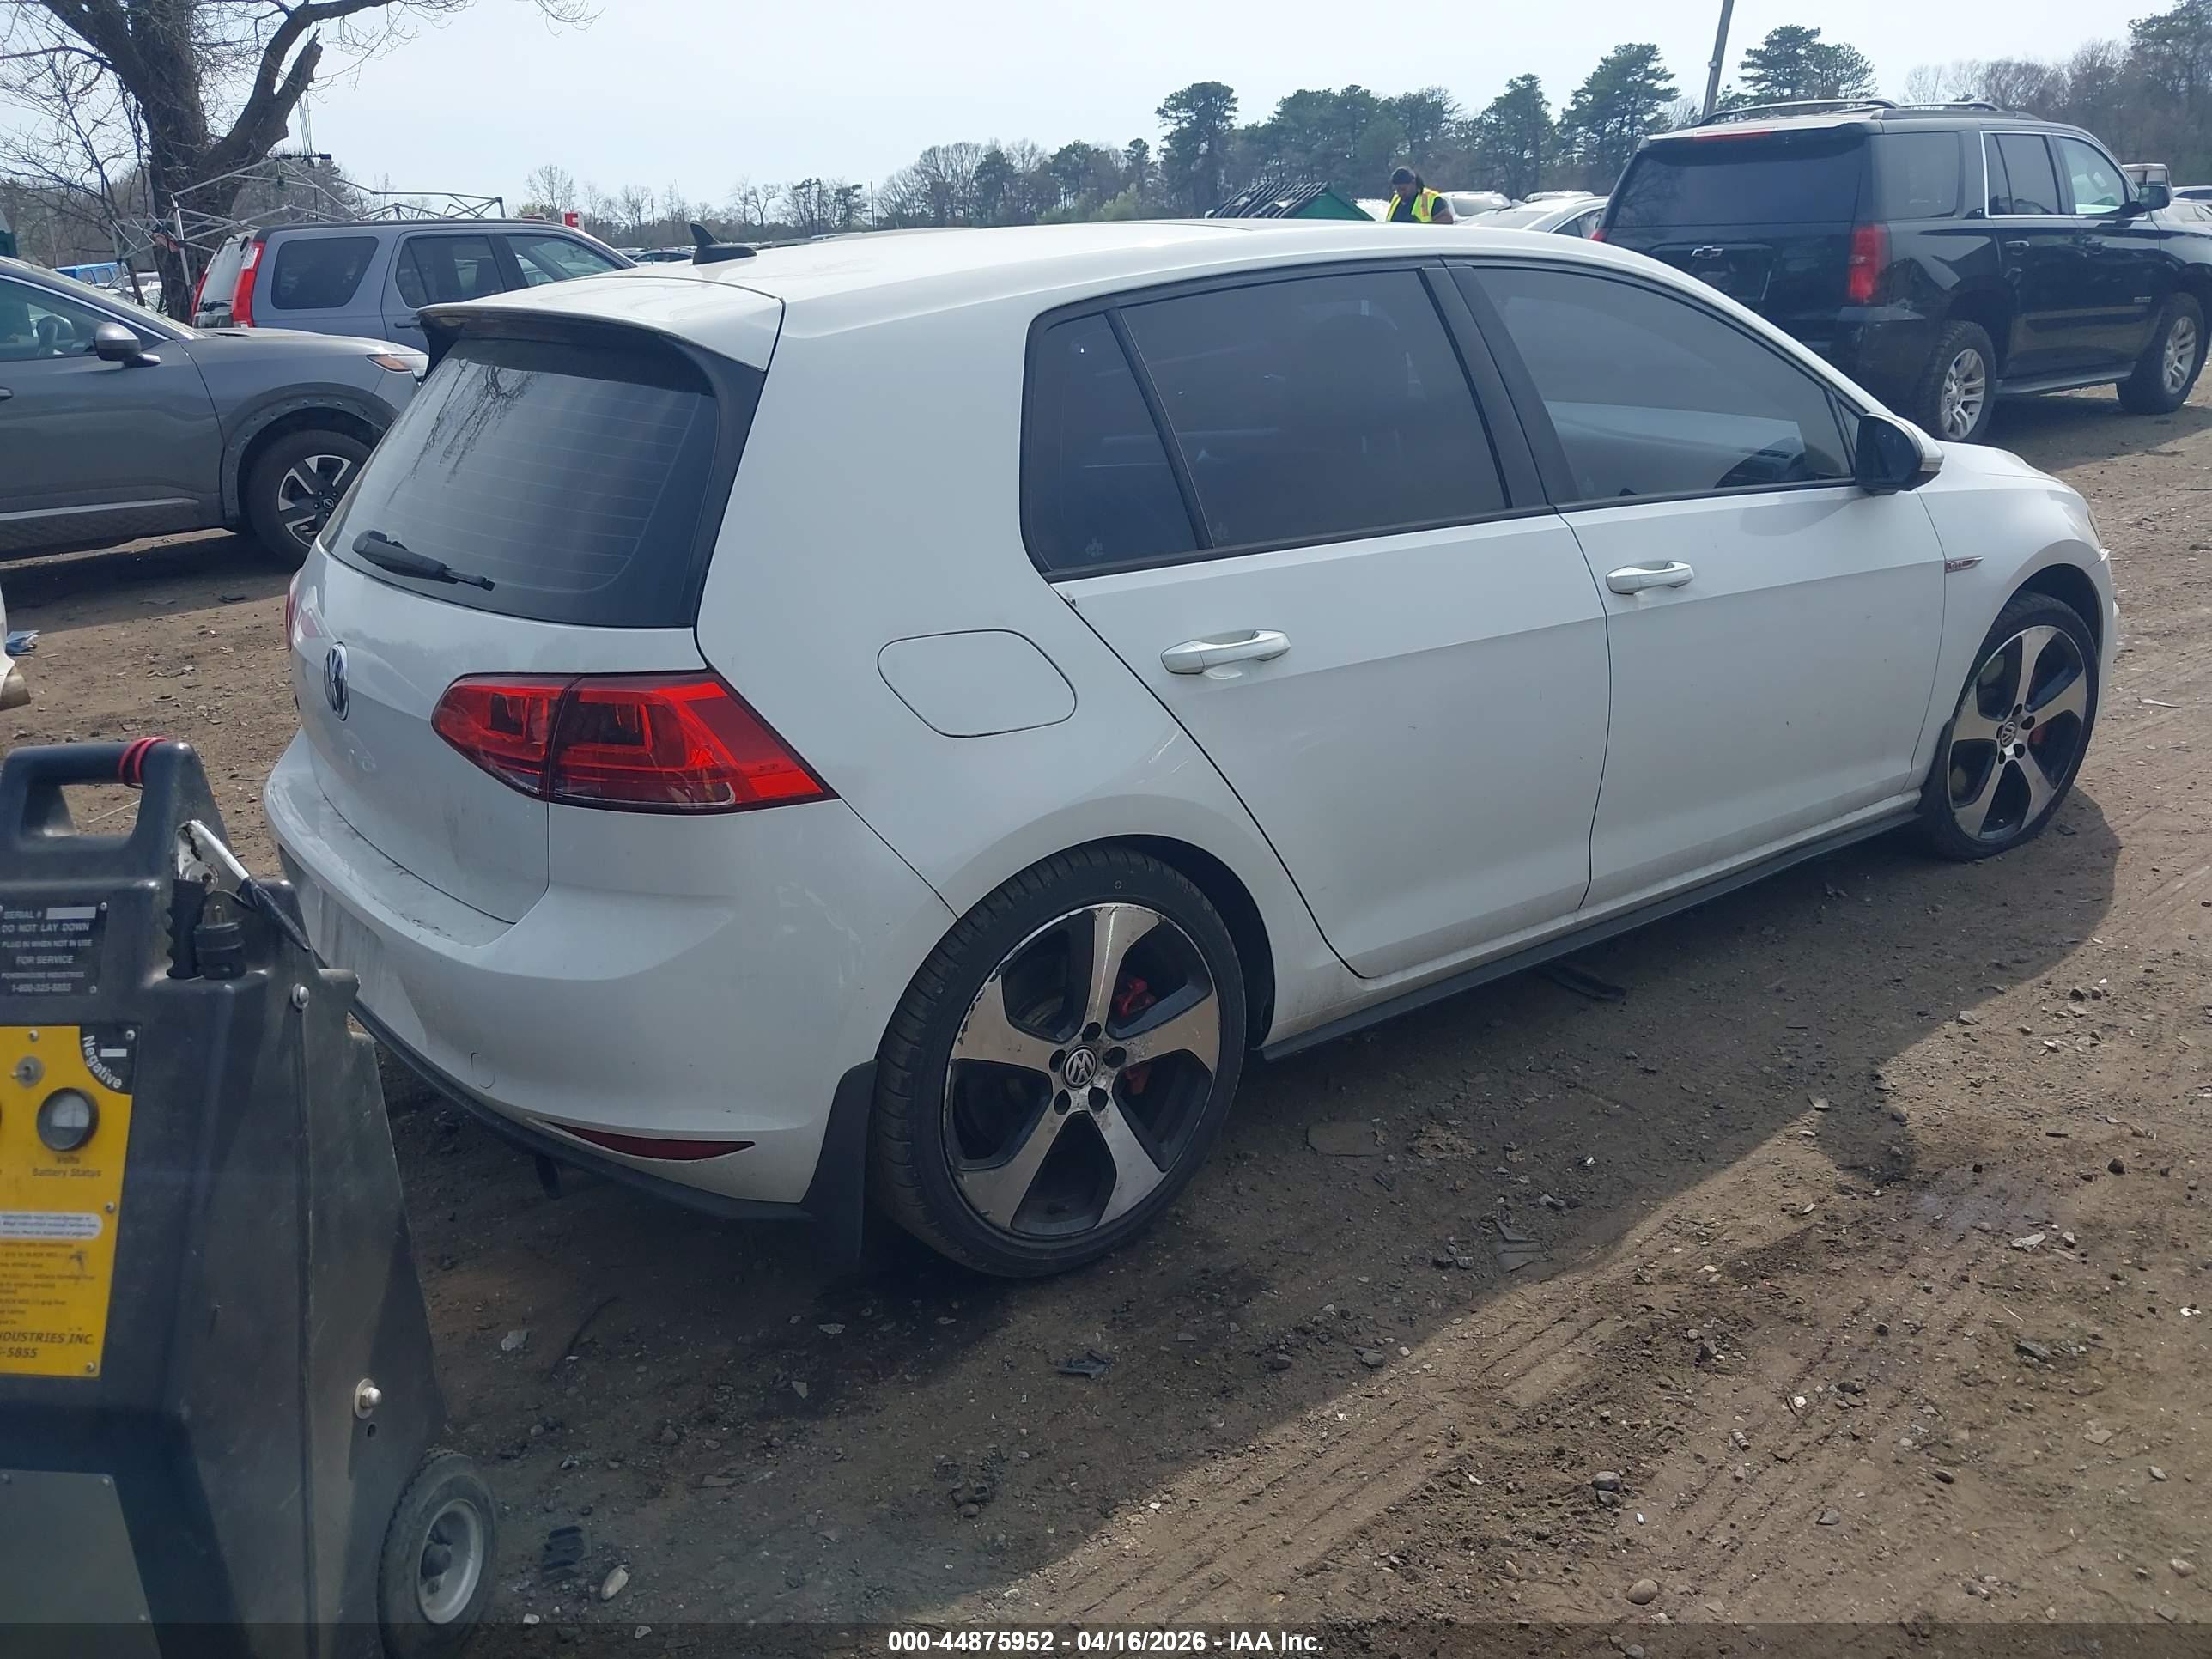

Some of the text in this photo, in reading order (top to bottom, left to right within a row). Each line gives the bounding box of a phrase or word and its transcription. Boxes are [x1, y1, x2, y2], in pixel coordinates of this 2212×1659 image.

[3, 910, 34, 920] SERIAL
[2, 924, 15, 933] DO
[40, 923, 58, 932] LAY
[62, 922, 89, 931] DOWN
[16, 955, 74, 964] FOR SERVICE
[82, 1035, 123, 1089] Negative
